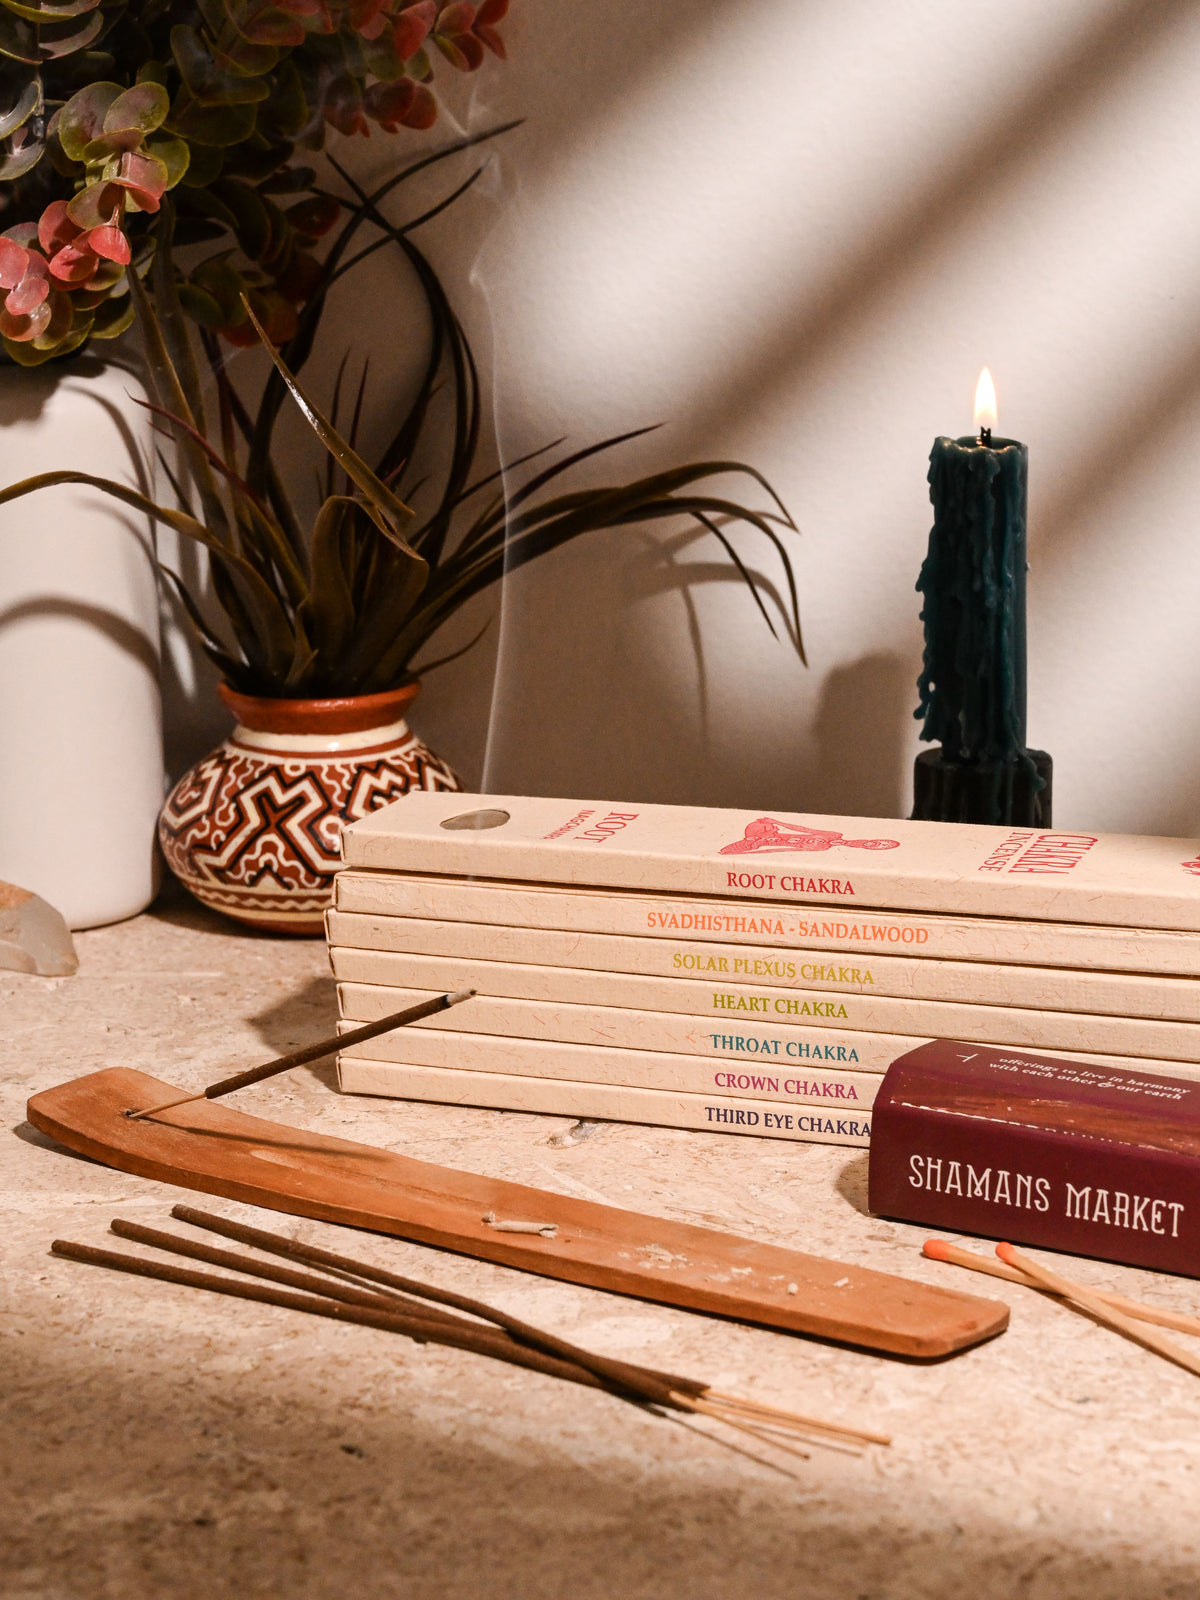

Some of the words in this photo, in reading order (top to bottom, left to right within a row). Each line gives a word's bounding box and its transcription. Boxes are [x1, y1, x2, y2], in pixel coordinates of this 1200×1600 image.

[573, 812, 640, 843] ROOT
[978, 832, 1035, 872] INCENSE
[1008, 833, 1099, 875] CHAKRA
[727, 872, 776, 890] ROOT
[780, 876, 855, 895] CHAKRA
[647, 912, 785, 935] SVADHISTHANA
[799, 921, 929, 944] SANDALWOOD
[673, 953, 730, 972] SOLAR
[733, 958, 797, 978] PLEXUS
[800, 963, 875, 985] CHAKRA
[713, 993, 771, 1011] HEART
[774, 999, 849, 1018] CHAKRA
[710, 1034, 782, 1054] THROAT
[786, 1042, 859, 1062] CHAKRA
[715, 1072, 779, 1092] CROWN
[784, 1079, 858, 1100] CHAKRA
[990, 1063, 1018, 1072] with
[1022, 1068, 1054, 1078] each
[1057, 1075, 1096, 1086] other
[1097, 1081, 1115, 1089] &
[1117, 1084, 1143, 1094] our
[1145, 1090, 1183, 1101] earth
[999, 1058, 1059, 1072] offerings
[1080, 1071, 1107, 1080] live
[1127, 1079, 1191, 1095] harmony
[705, 1107, 759, 1126] THIRD
[764, 1113, 794, 1129] EYE
[797, 1117, 871, 1137] CHAKRA
[908, 1155, 1051, 1213] SHAMANS
[1065, 1182, 1185, 1238] MARKET
